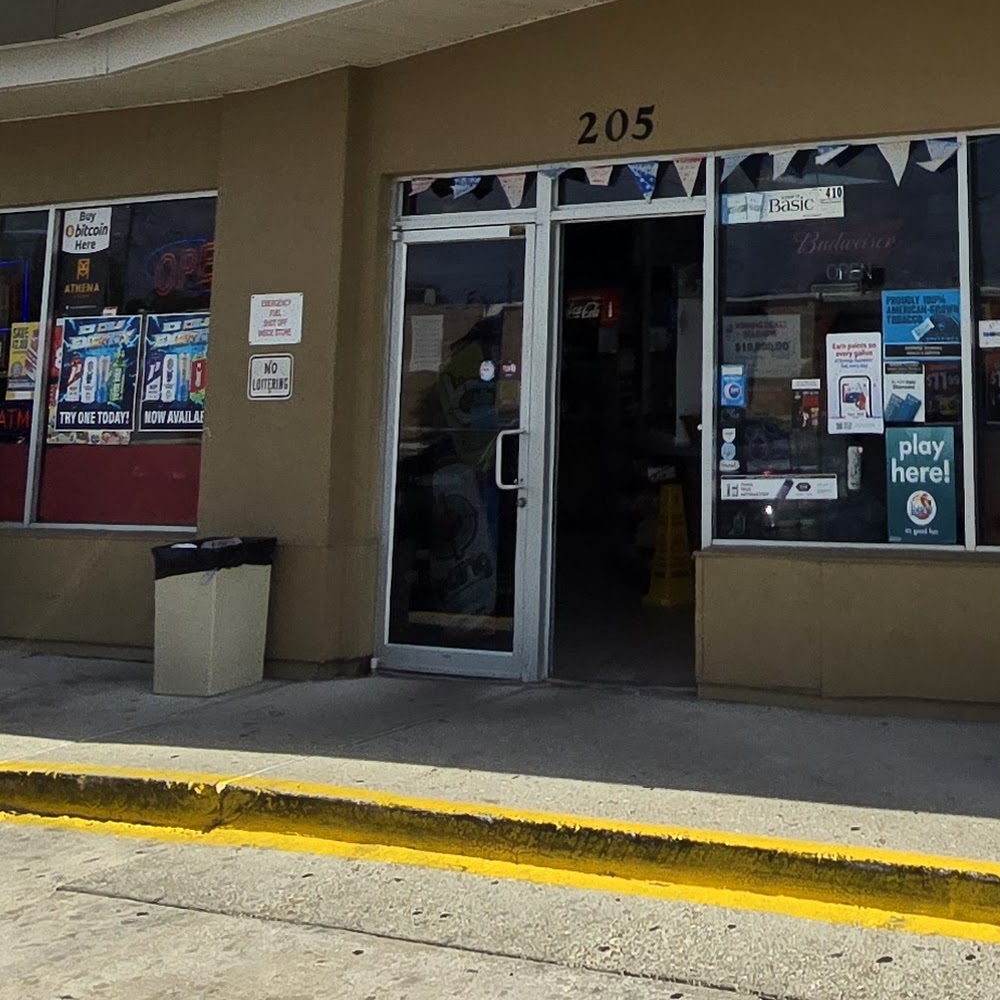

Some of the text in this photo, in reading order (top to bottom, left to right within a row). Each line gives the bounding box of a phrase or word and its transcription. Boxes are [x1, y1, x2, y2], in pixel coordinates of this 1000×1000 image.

[577, 104, 655, 145] 205
[825, 187, 842, 199] 410
[769, 196, 814, 213] Basic
[79, 211, 97, 223] Buy
[75, 223, 109, 237] bitcoin
[75, 240, 96, 250] Here
[64, 283, 100, 293] ATHENA
[264, 362, 278, 374] NO
[252, 378, 288, 391] LOITERING
[60, 410, 130, 425] TRY ONE TODAY!
[144, 410, 167, 424] NOW
[899, 433, 945, 461] play
[891, 457, 951, 484] here!
